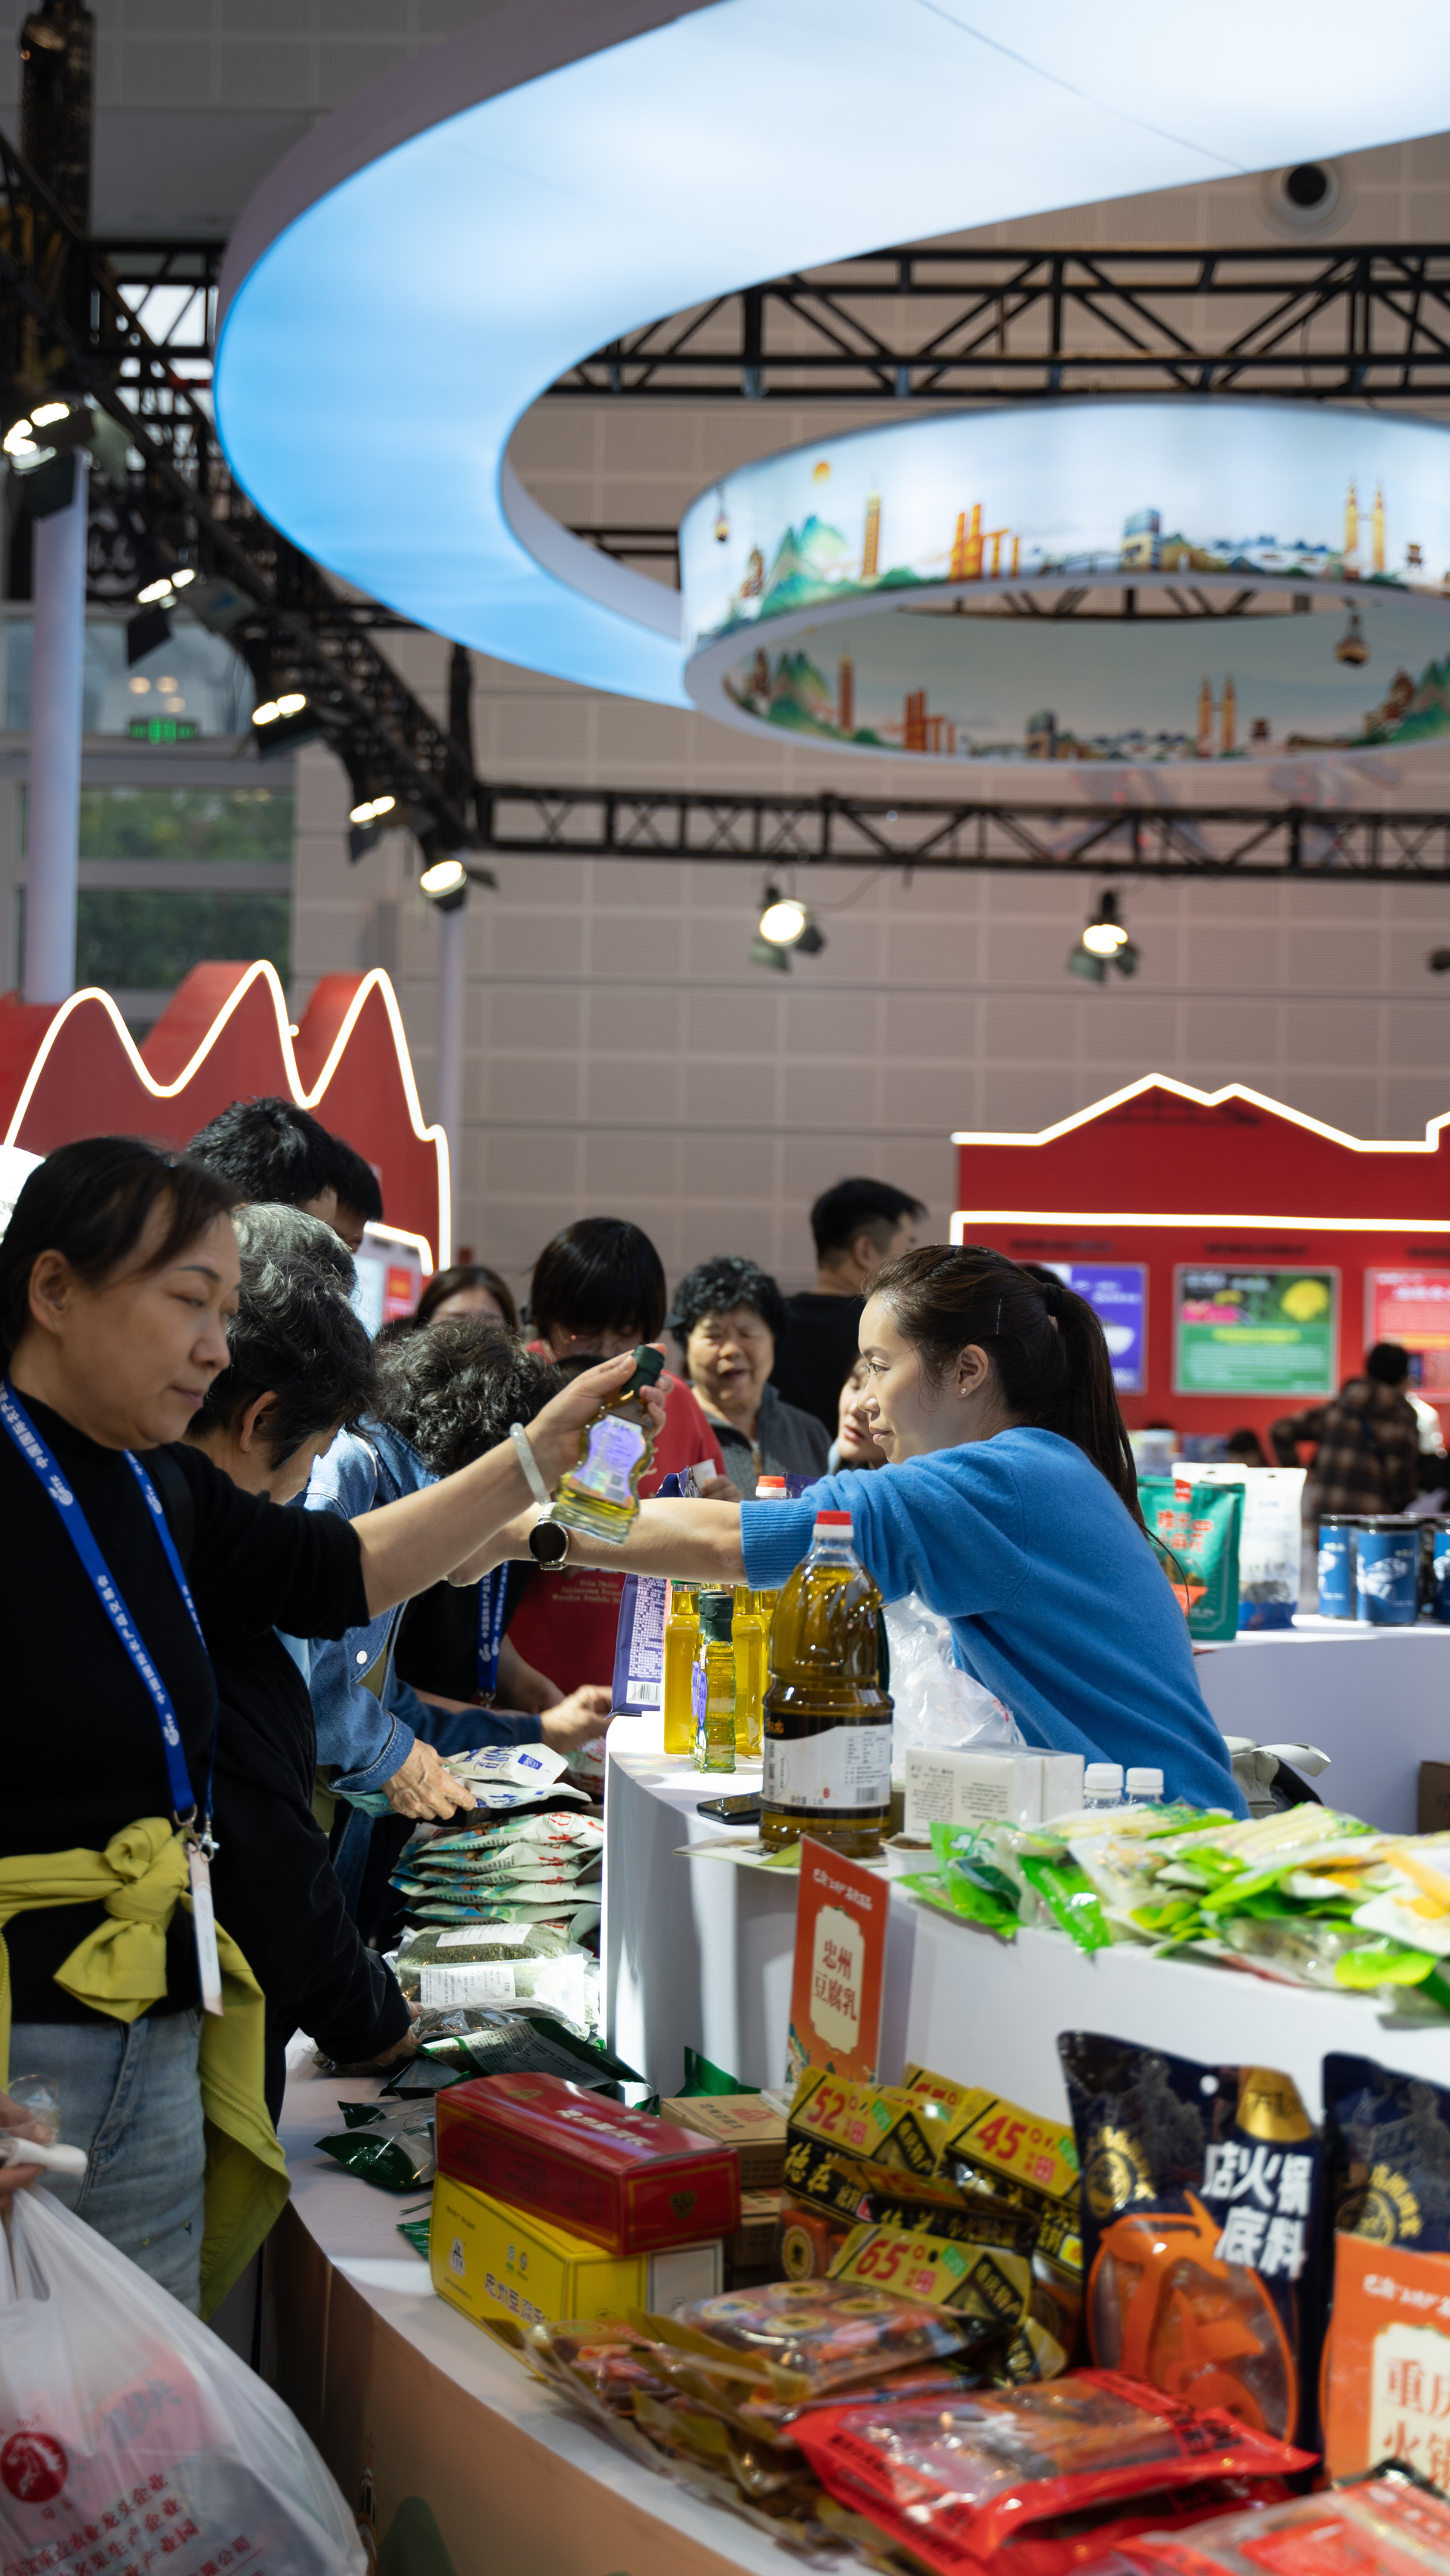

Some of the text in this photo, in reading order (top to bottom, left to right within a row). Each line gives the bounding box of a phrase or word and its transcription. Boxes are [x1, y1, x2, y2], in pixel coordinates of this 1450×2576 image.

[822, 1938, 853, 1981] 忠州
[813, 1967, 858, 2022] 豆腐乳
[1214, 2205, 1308, 2282] 底料
